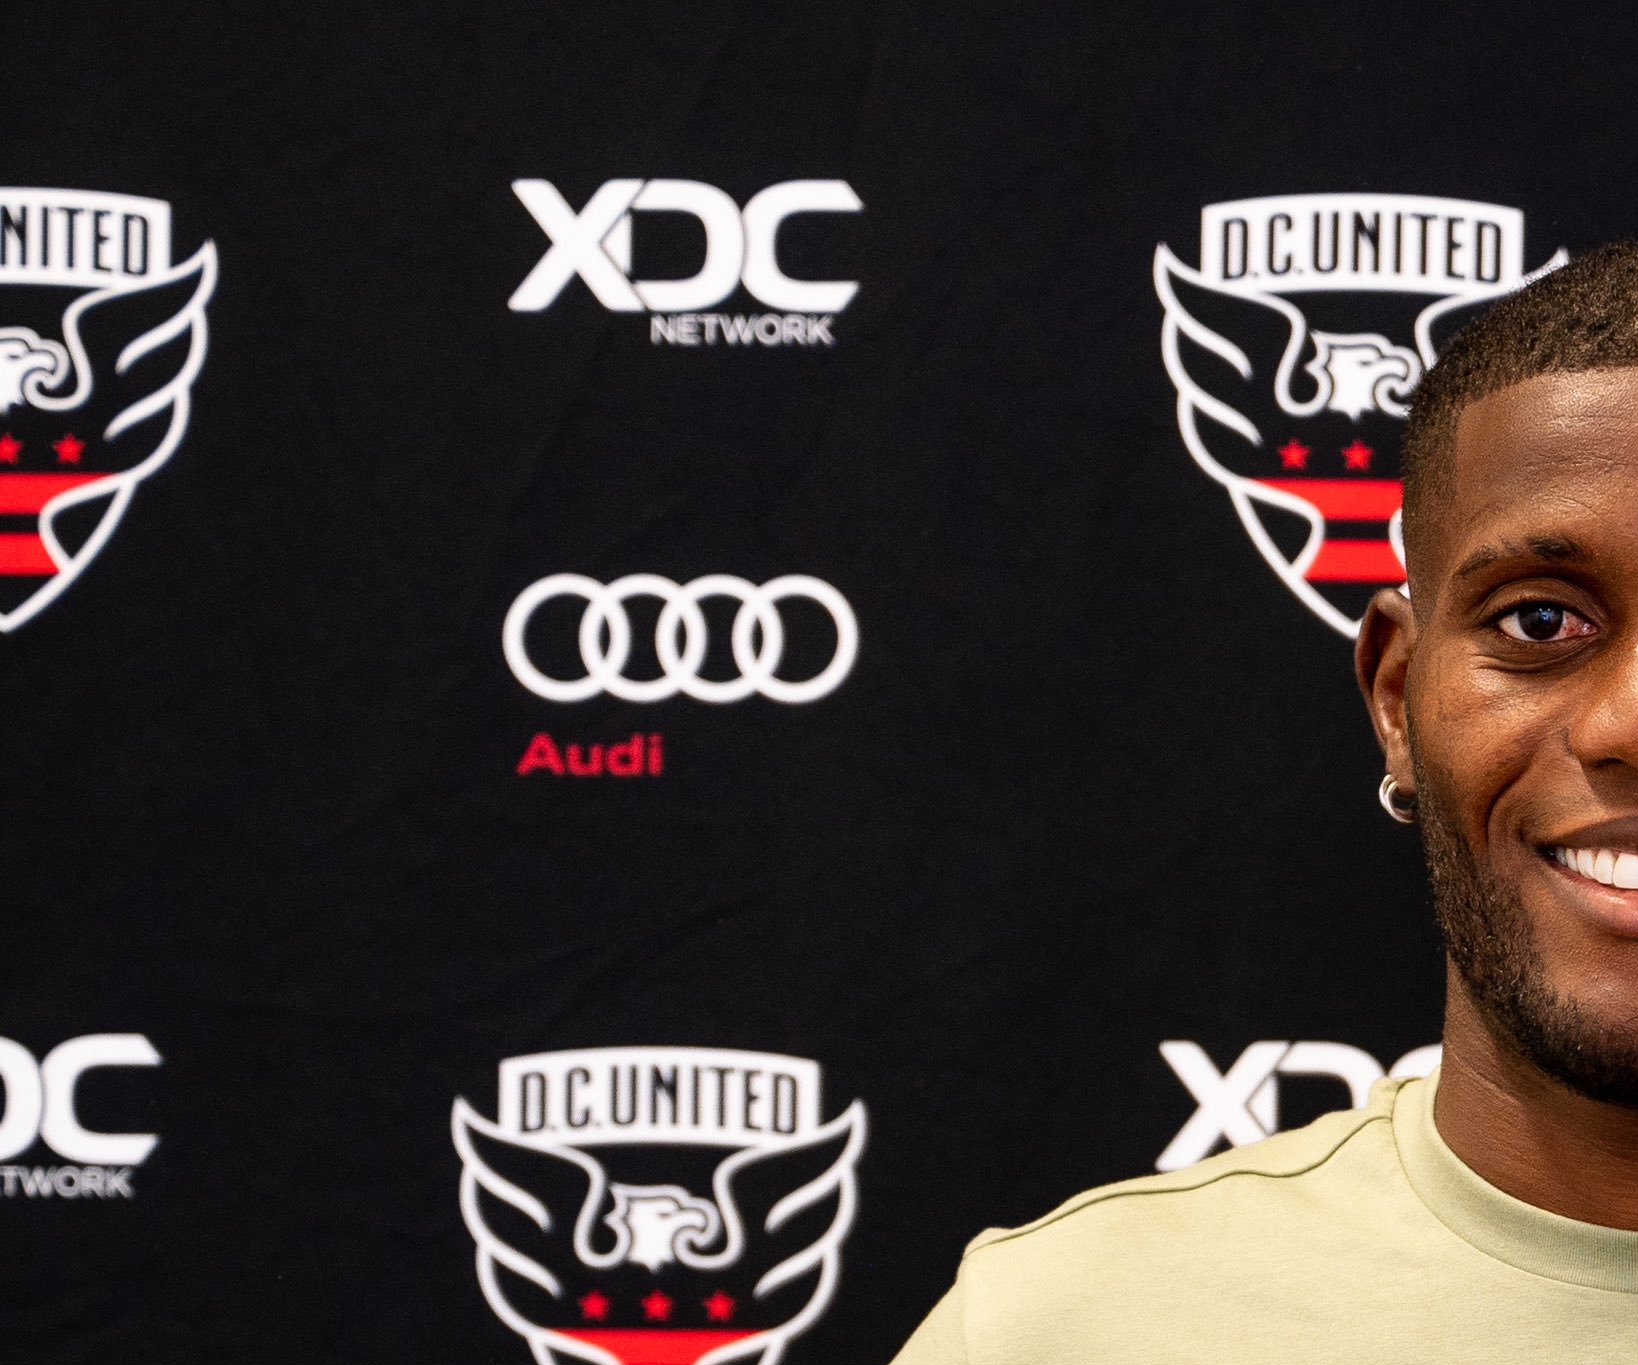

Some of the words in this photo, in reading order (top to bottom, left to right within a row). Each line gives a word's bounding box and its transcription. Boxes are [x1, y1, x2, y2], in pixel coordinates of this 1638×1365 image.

[508, 178, 866, 313] XDC
[650, 314, 836, 347] NETWORK
[516, 731, 664, 776] Audi
[1155, 1040, 1442, 1172] XD
